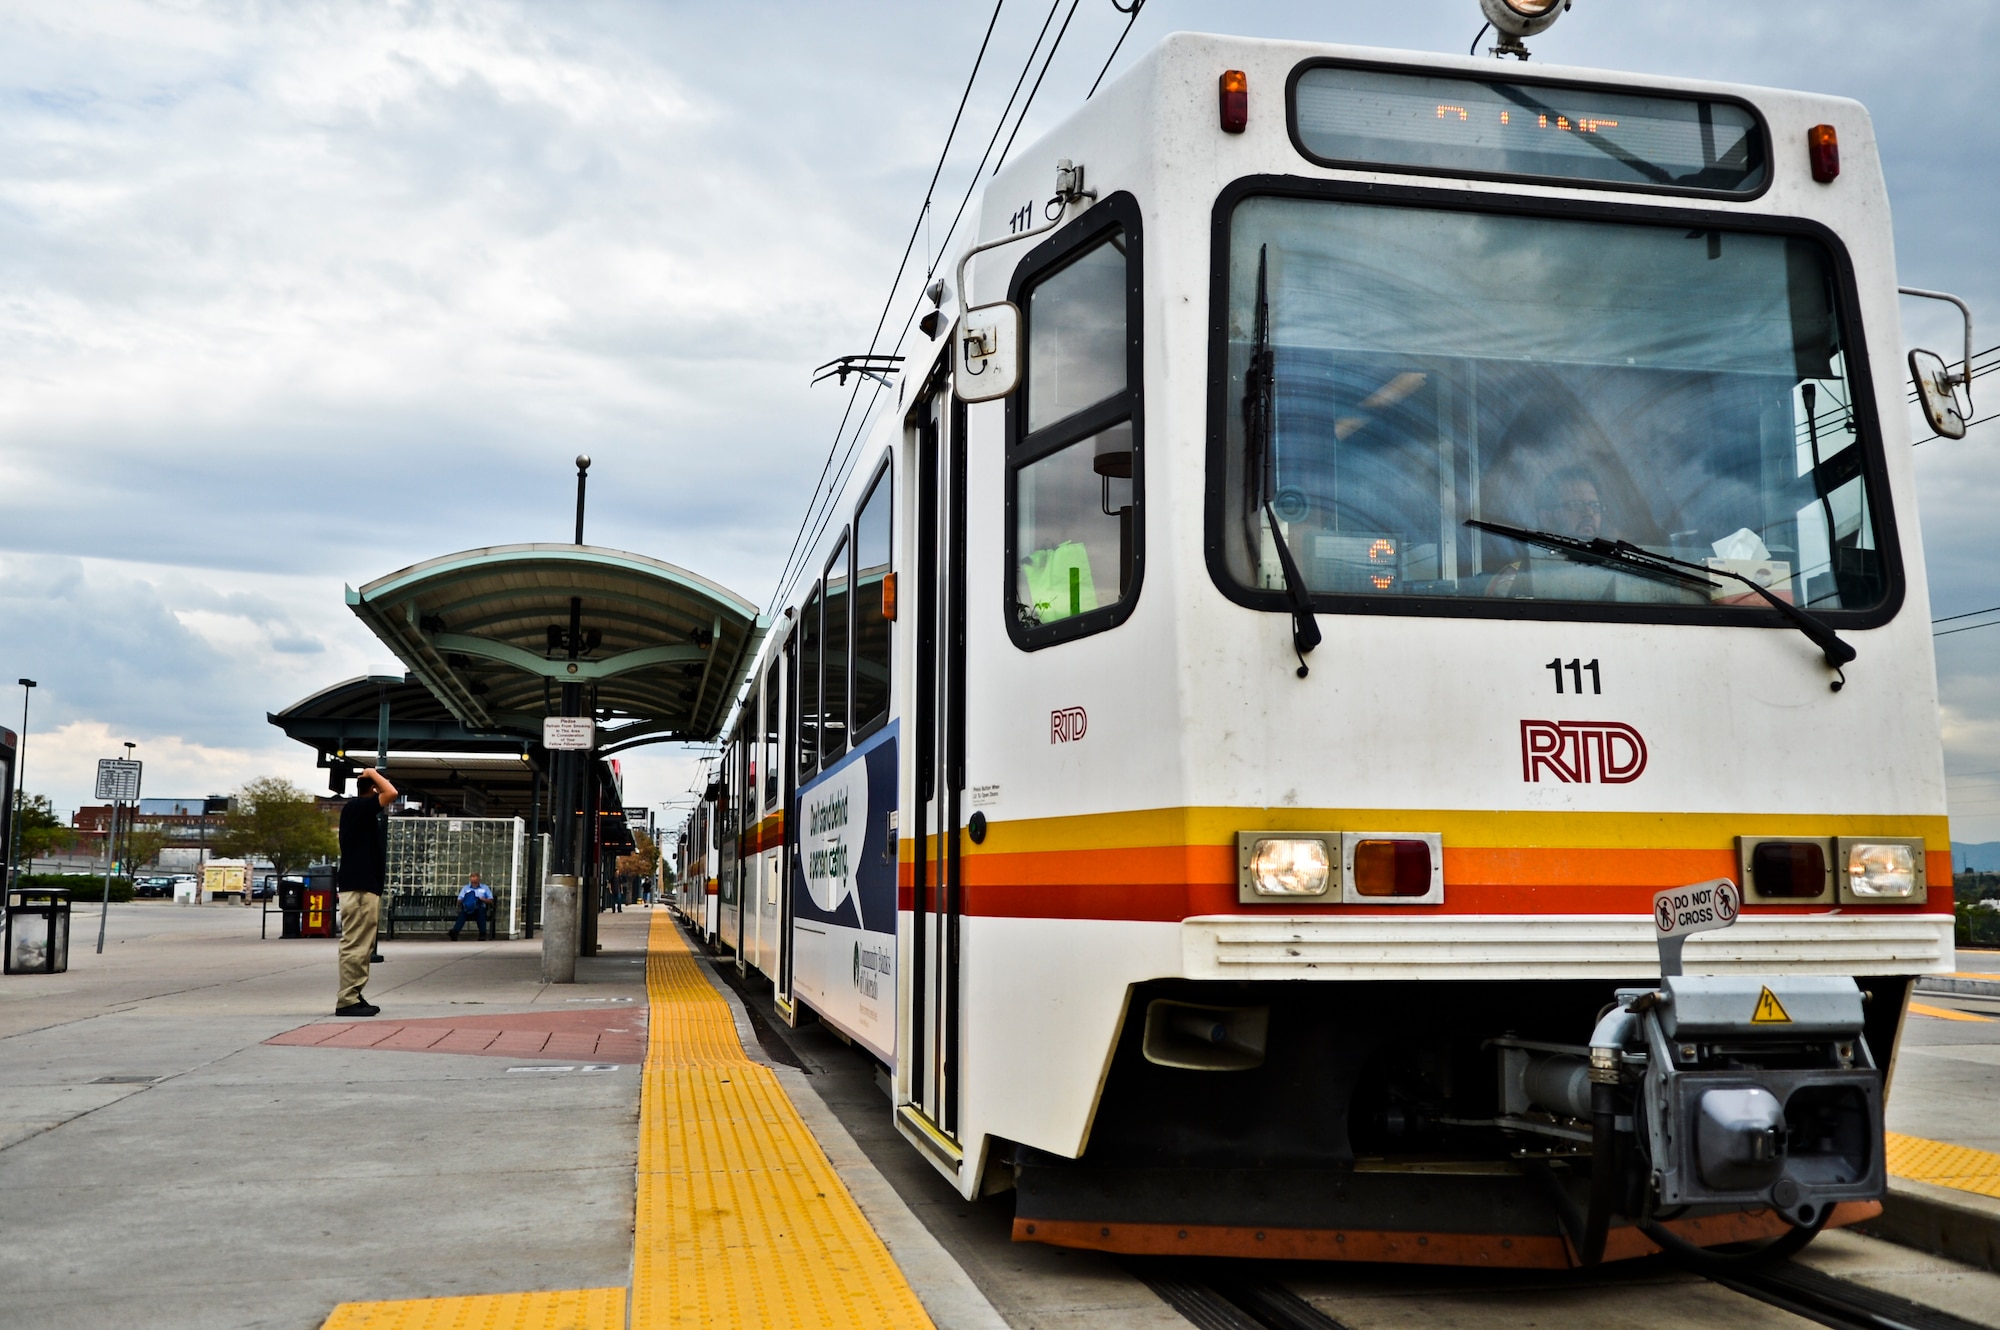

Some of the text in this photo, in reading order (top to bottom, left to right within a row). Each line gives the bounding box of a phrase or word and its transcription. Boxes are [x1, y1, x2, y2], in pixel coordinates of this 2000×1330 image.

[1009, 199, 1033, 234] 111
[1545, 658, 1602, 695] 111
[1051, 706, 1088, 745] RTD
[1520, 719, 1648, 784] RTD
[820, 793, 832, 834] stand
[832, 784, 849, 830] behind
[812, 848, 828, 890] person
[1674, 889, 1712, 910] DO NOT
[1678, 907, 1714, 927] CROSS
